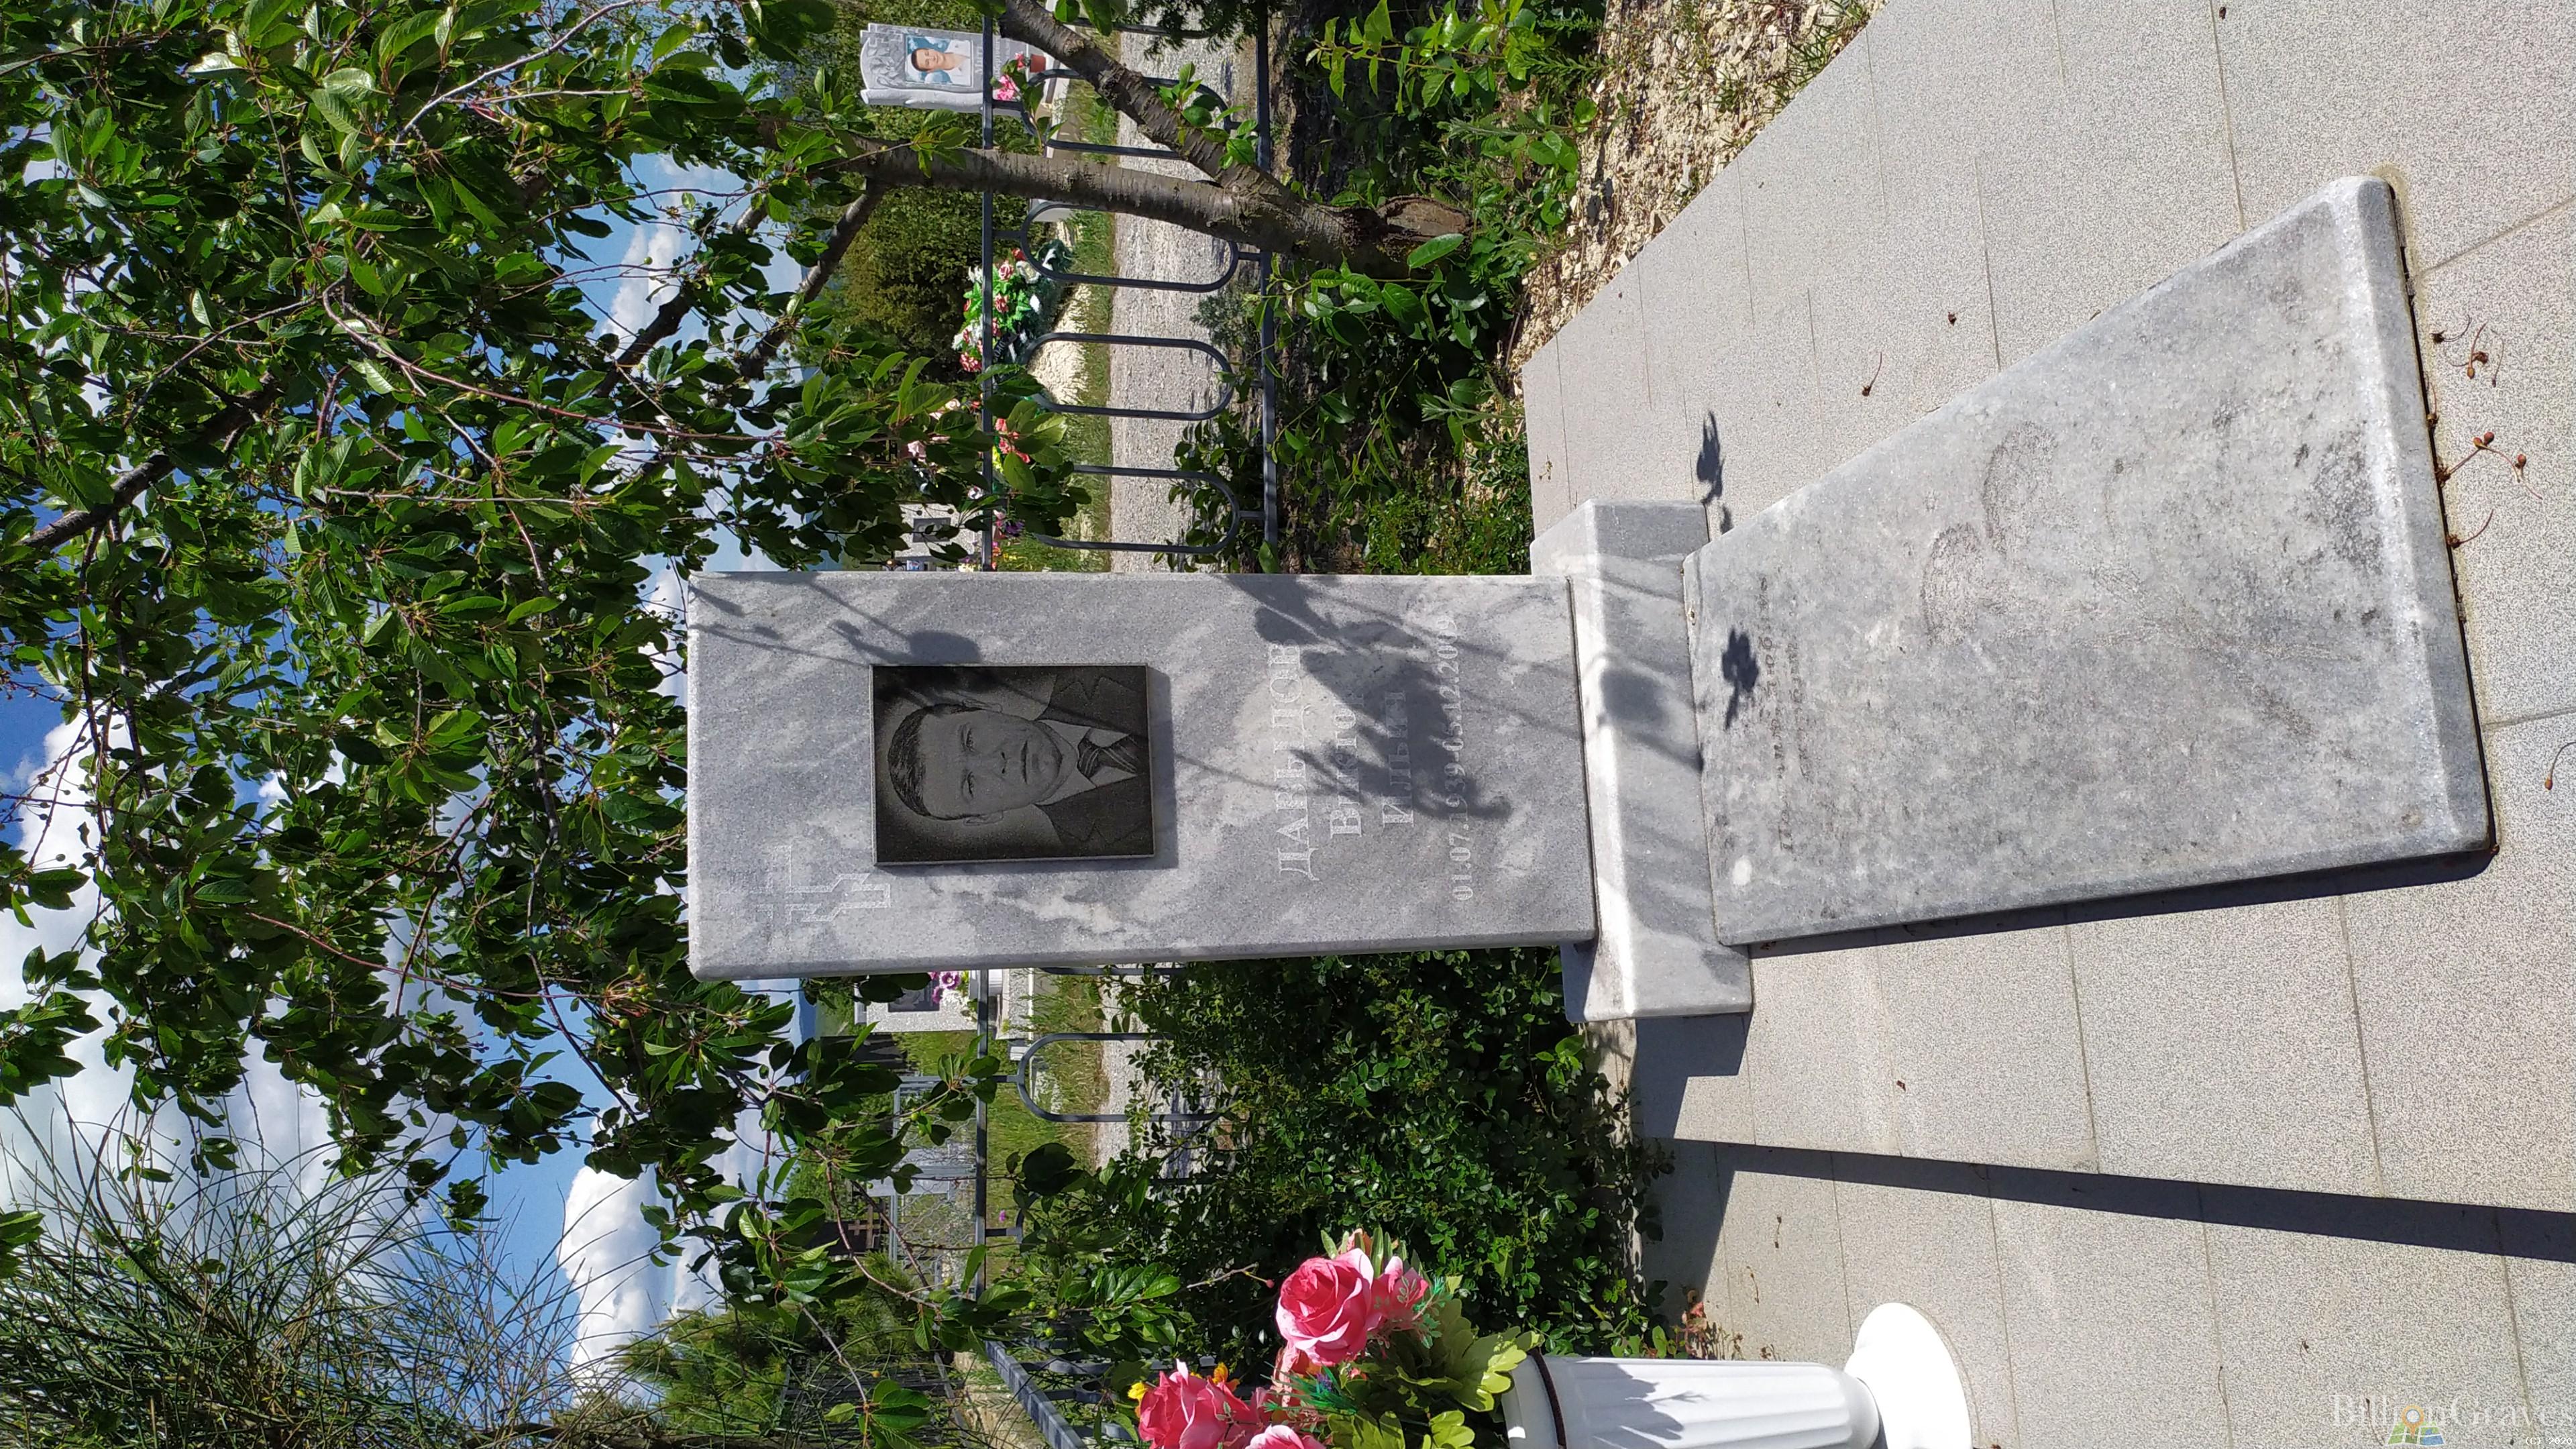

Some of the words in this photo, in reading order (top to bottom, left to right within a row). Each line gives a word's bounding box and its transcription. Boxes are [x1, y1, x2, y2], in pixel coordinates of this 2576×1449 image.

[1267, 641, 1319, 881] ДАВЫДОВ
[1330, 692, 1363, 838] Виктор
[1381, 691, 1414, 827] Ильич
